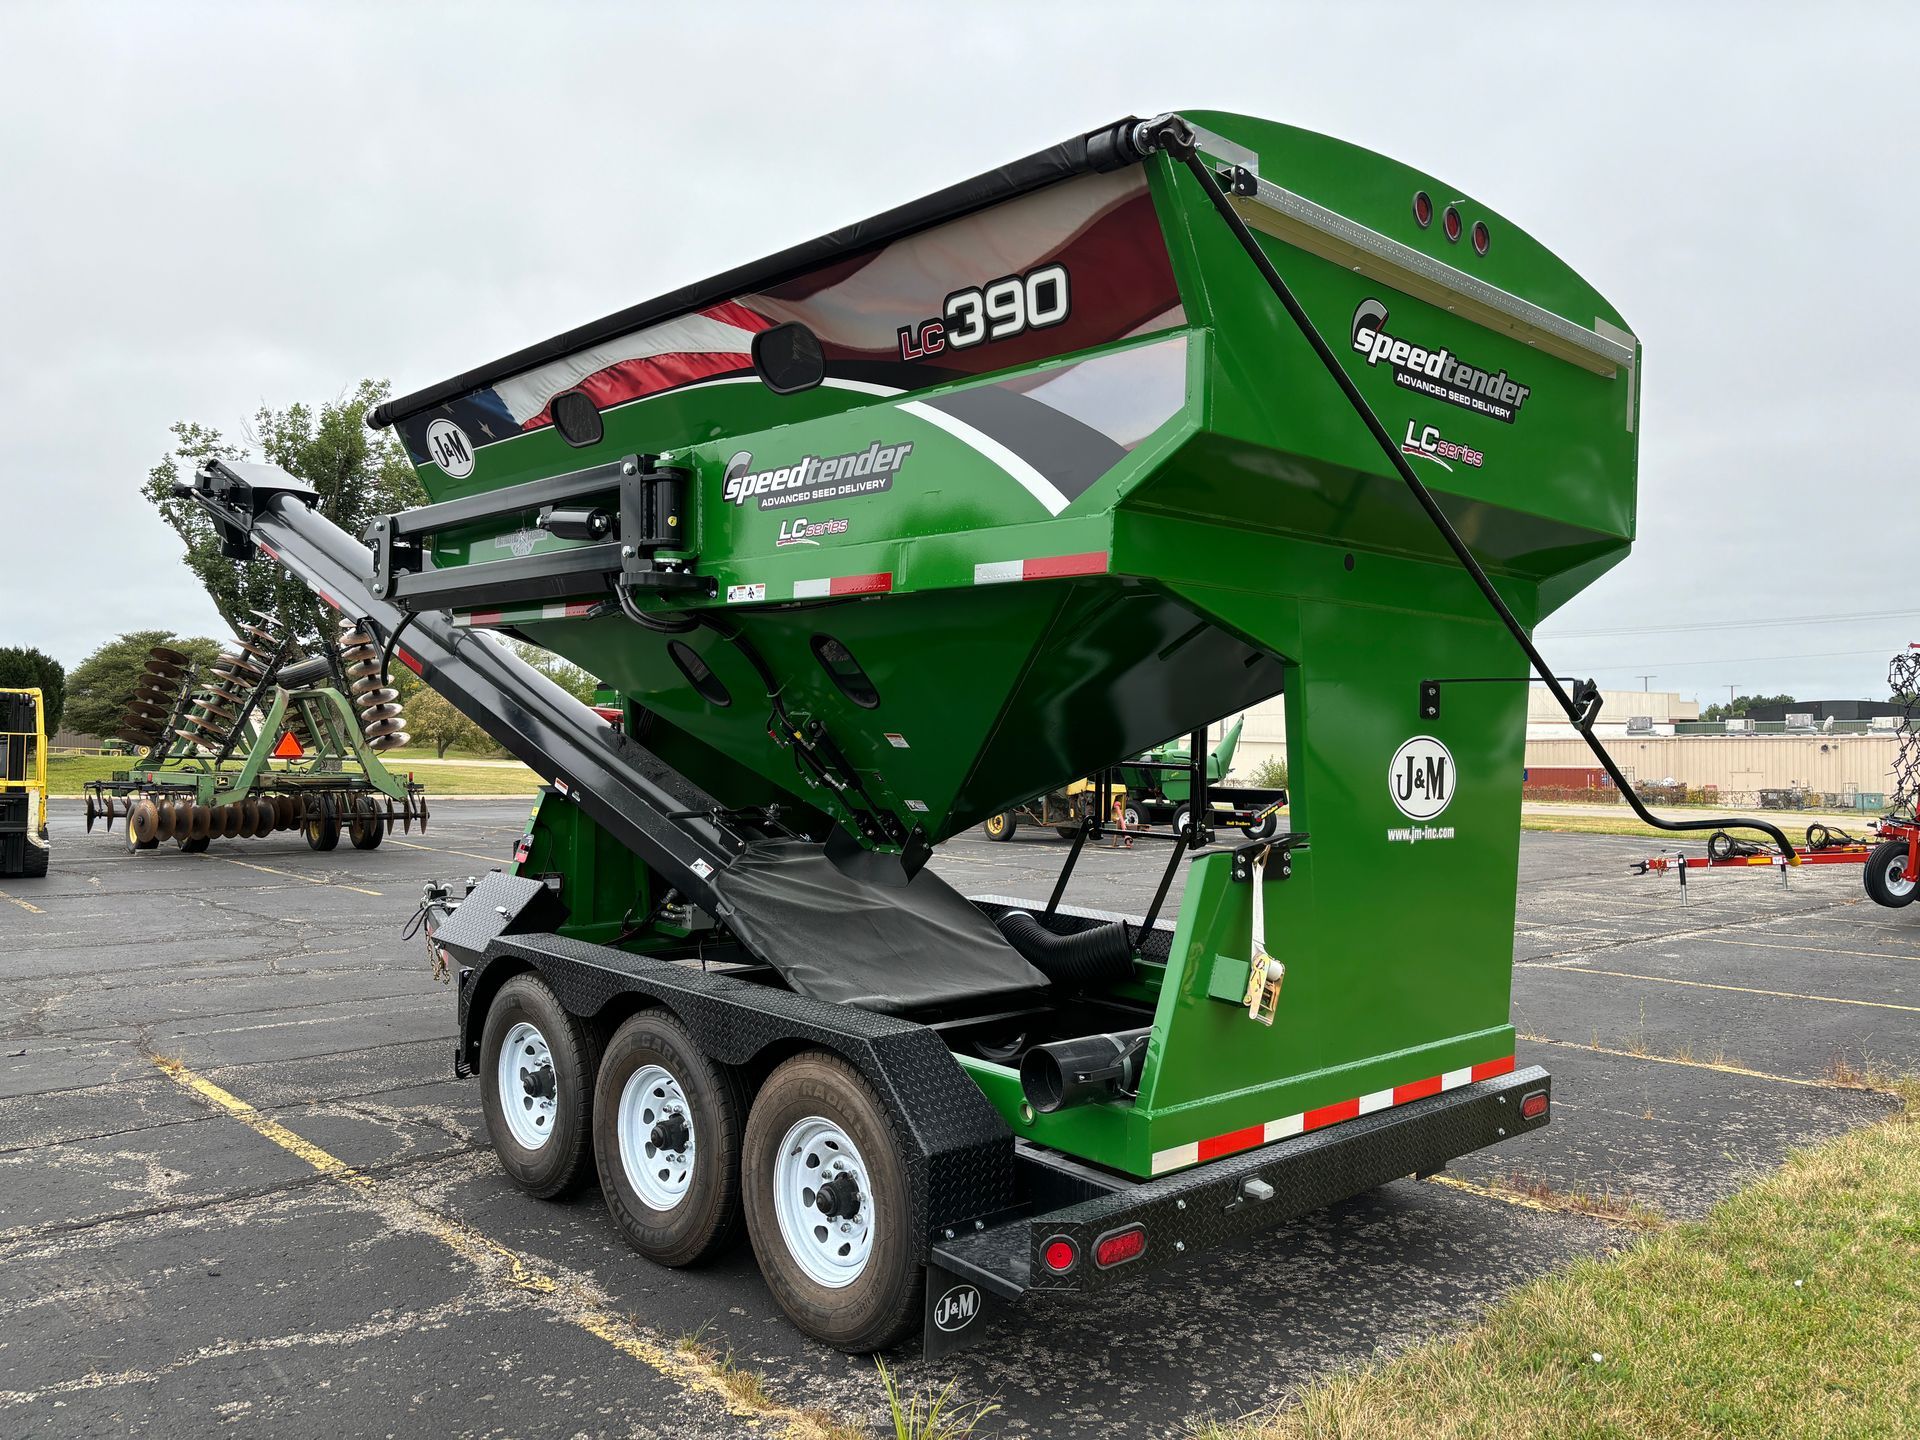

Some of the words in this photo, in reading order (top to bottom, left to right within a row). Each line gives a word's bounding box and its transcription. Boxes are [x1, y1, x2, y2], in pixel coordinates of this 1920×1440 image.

[1396, 373, 1447, 397] ADVANCED
[1448, 390, 1471, 406] SEED
[1472, 398, 1511, 419] DELIVERY
[433, 429, 471, 468] J&M
[761, 492, 810, 508] ADVANCED
[811, 487, 837, 499] SEED
[838, 478, 887, 495] DELIVERY
[1396, 755, 1446, 801] J&M
[1387, 824, 1455, 844] www.jm-inc.com
[937, 1290, 975, 1325] J&M
